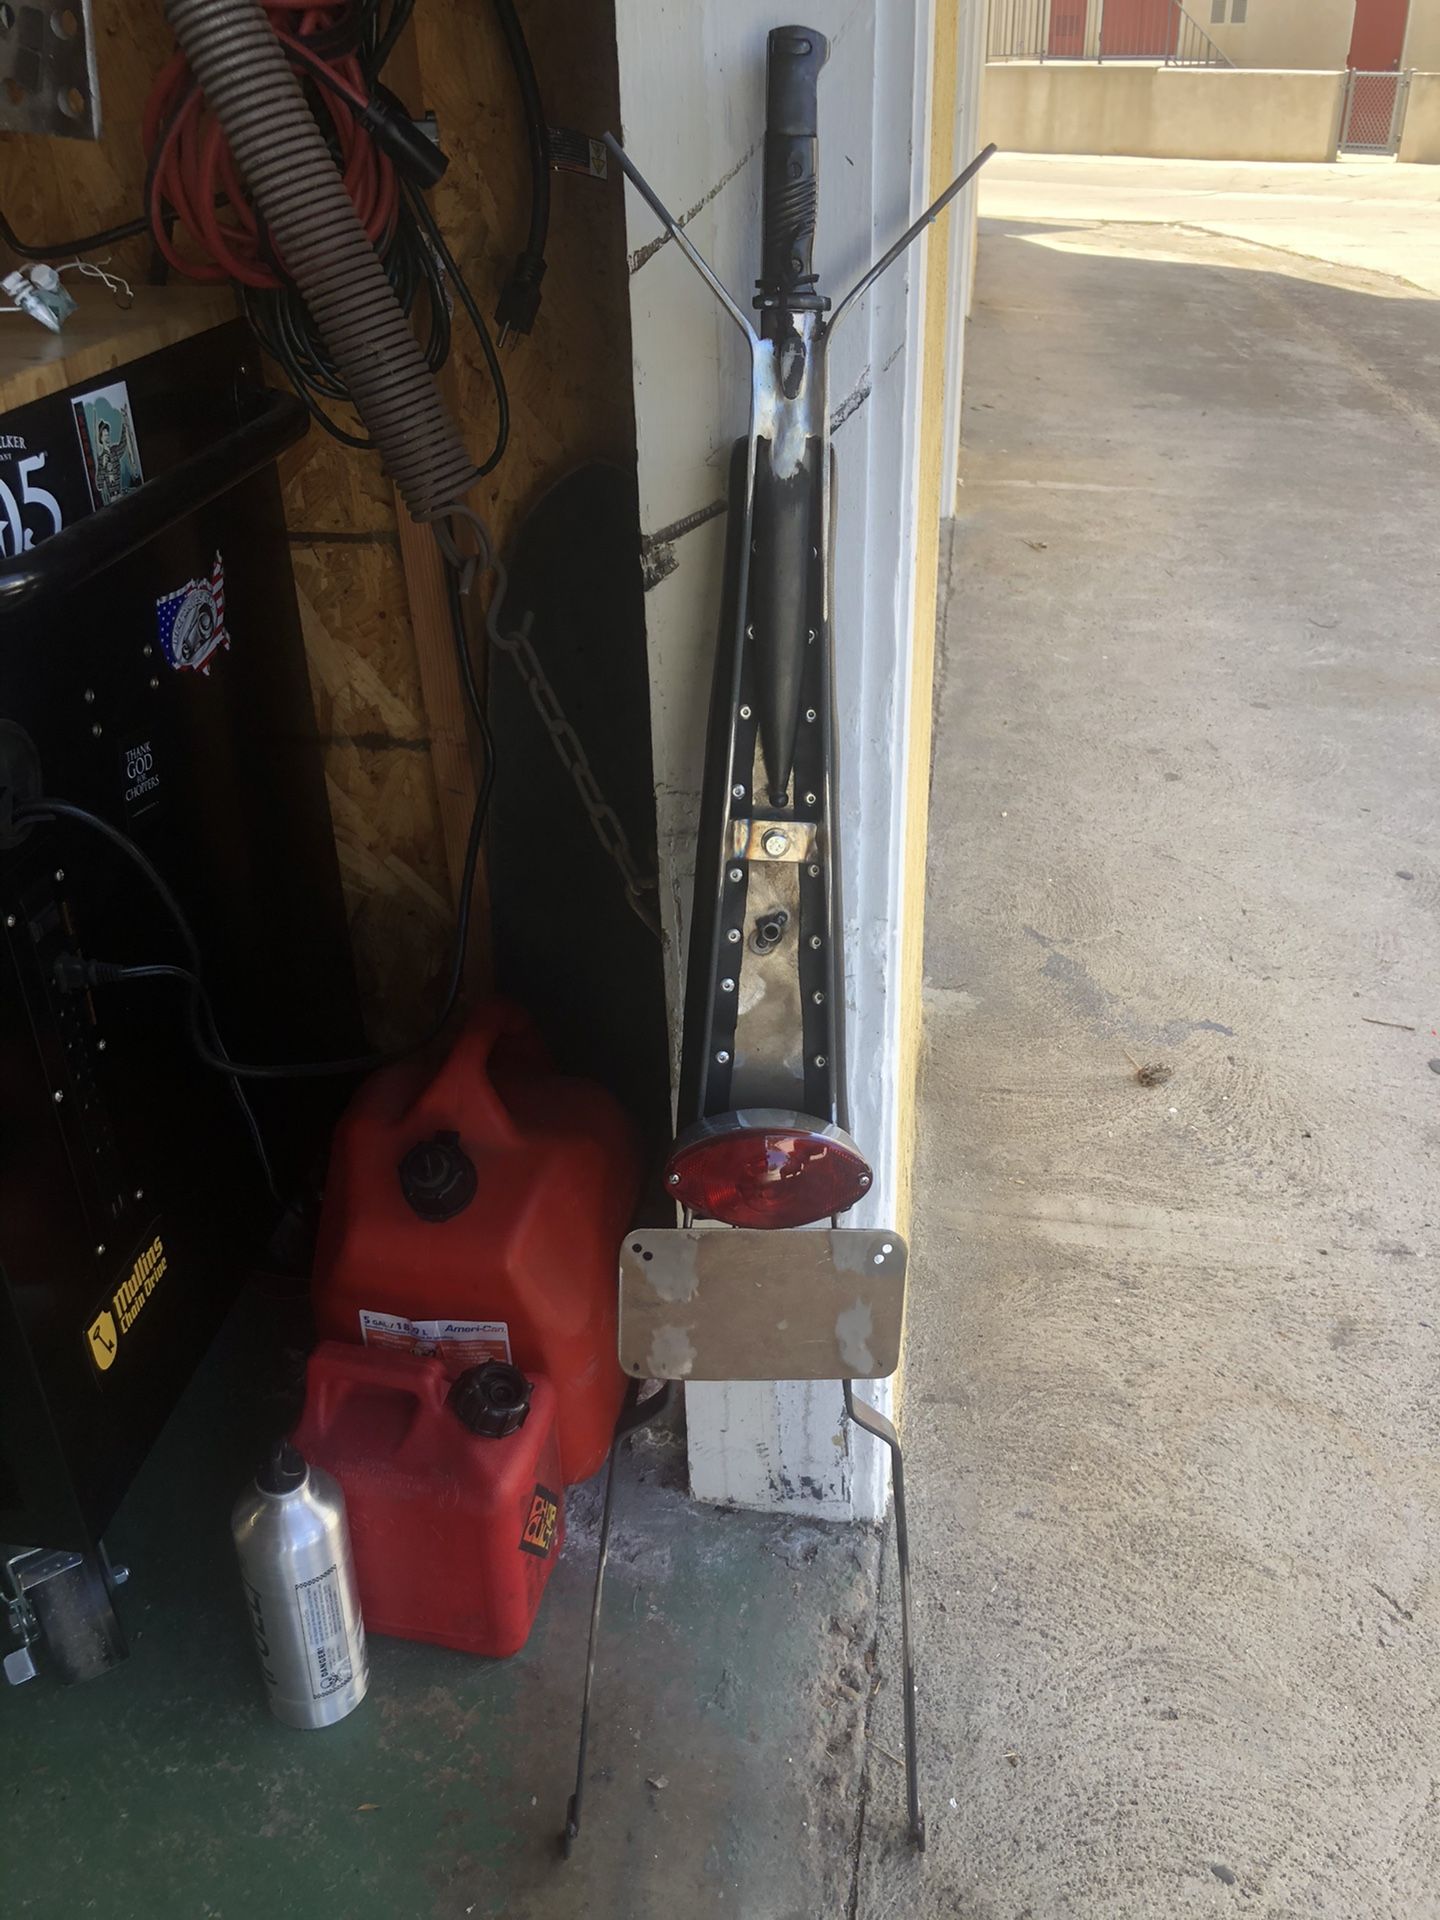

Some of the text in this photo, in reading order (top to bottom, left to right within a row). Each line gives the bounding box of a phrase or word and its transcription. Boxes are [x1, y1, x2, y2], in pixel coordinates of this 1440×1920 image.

[125, 741, 152, 762] THANK
[127, 753, 153, 779] GOD
[125, 774, 161, 801] CHOPPERS
[113, 1235, 163, 1319] Mullins
[120, 1257, 168, 1335] Chain Drive
[364, 1315, 370, 1324] 5
